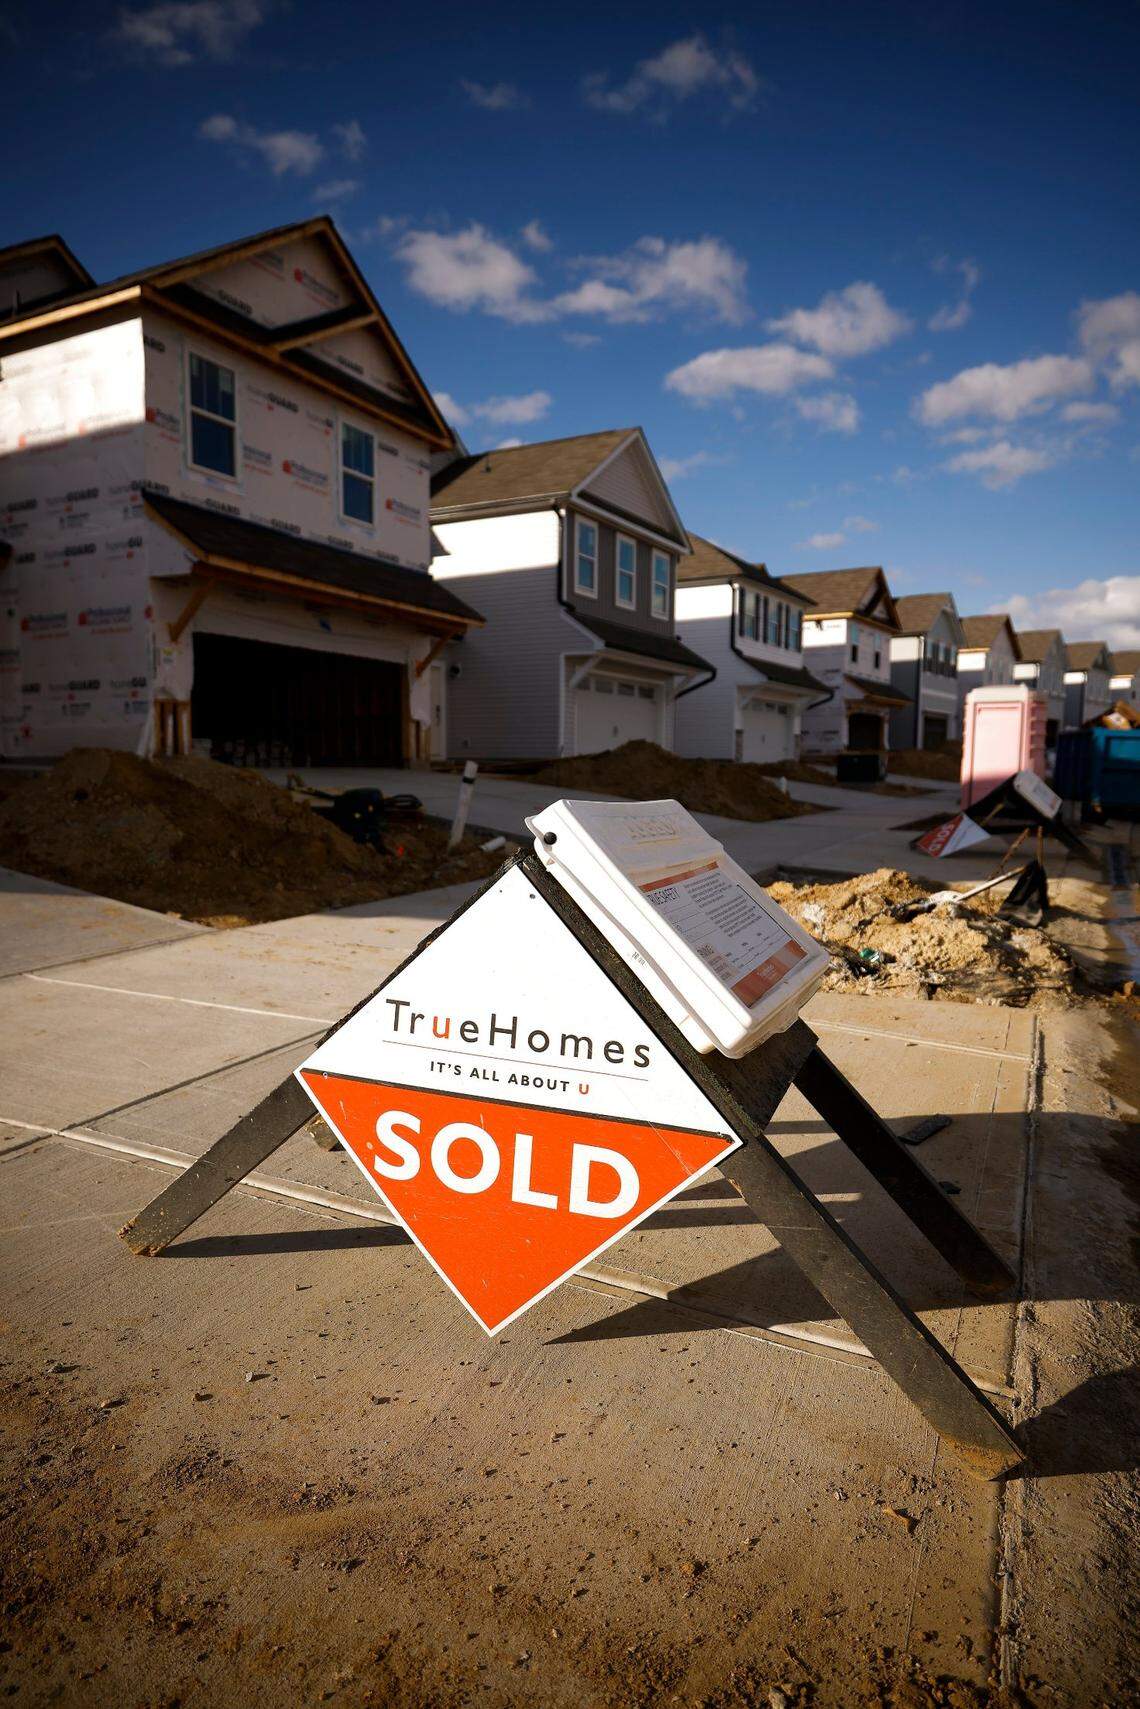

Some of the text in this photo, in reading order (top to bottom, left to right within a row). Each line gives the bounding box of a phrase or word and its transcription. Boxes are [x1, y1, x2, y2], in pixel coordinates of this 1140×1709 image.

[385, 998, 651, 1068] TrueHomes
[430, 1061, 590, 1095] IT'S ALL ABOUT U
[373, 1110, 641, 1219] SOLD
